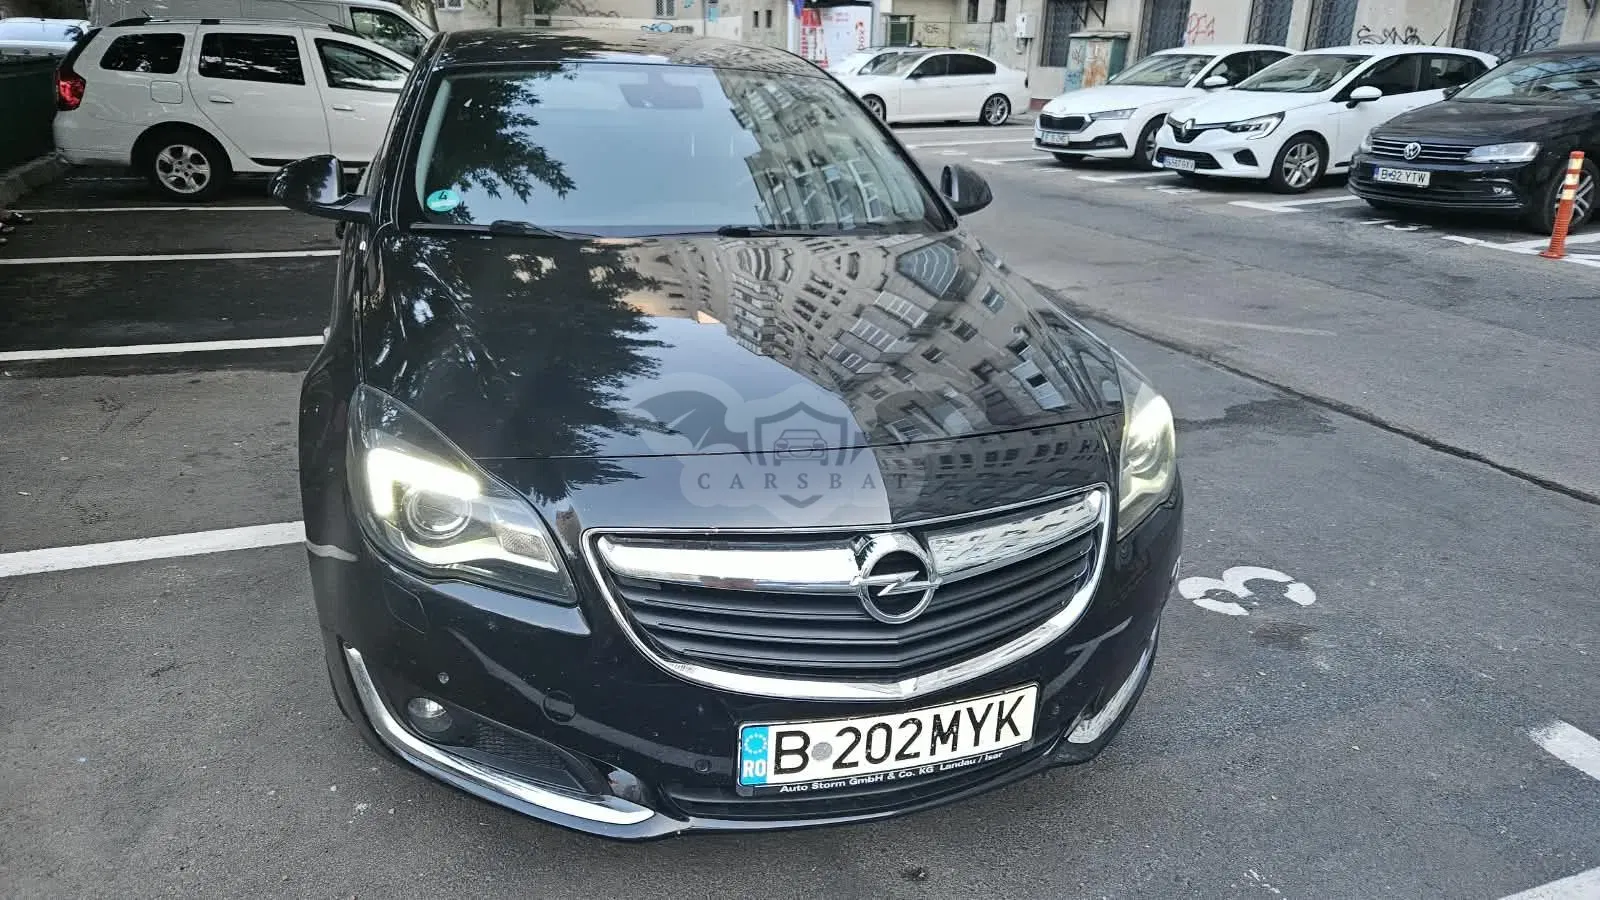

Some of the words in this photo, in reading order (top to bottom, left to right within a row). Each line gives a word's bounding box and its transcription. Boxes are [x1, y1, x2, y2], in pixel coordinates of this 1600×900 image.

[743, 760, 766, 777] RO
[774, 730, 810, 775] B
[780, 785, 808, 793] Auto
[811, 781, 846, 790] Storm
[849, 775, 884, 785] GmbH
[887, 771, 895, 780] &
[898, 770, 916, 778] Co.
[919, 766, 934, 775] KG
[940, 759, 976, 771] Landau
[985, 752, 1003, 761] Isar
